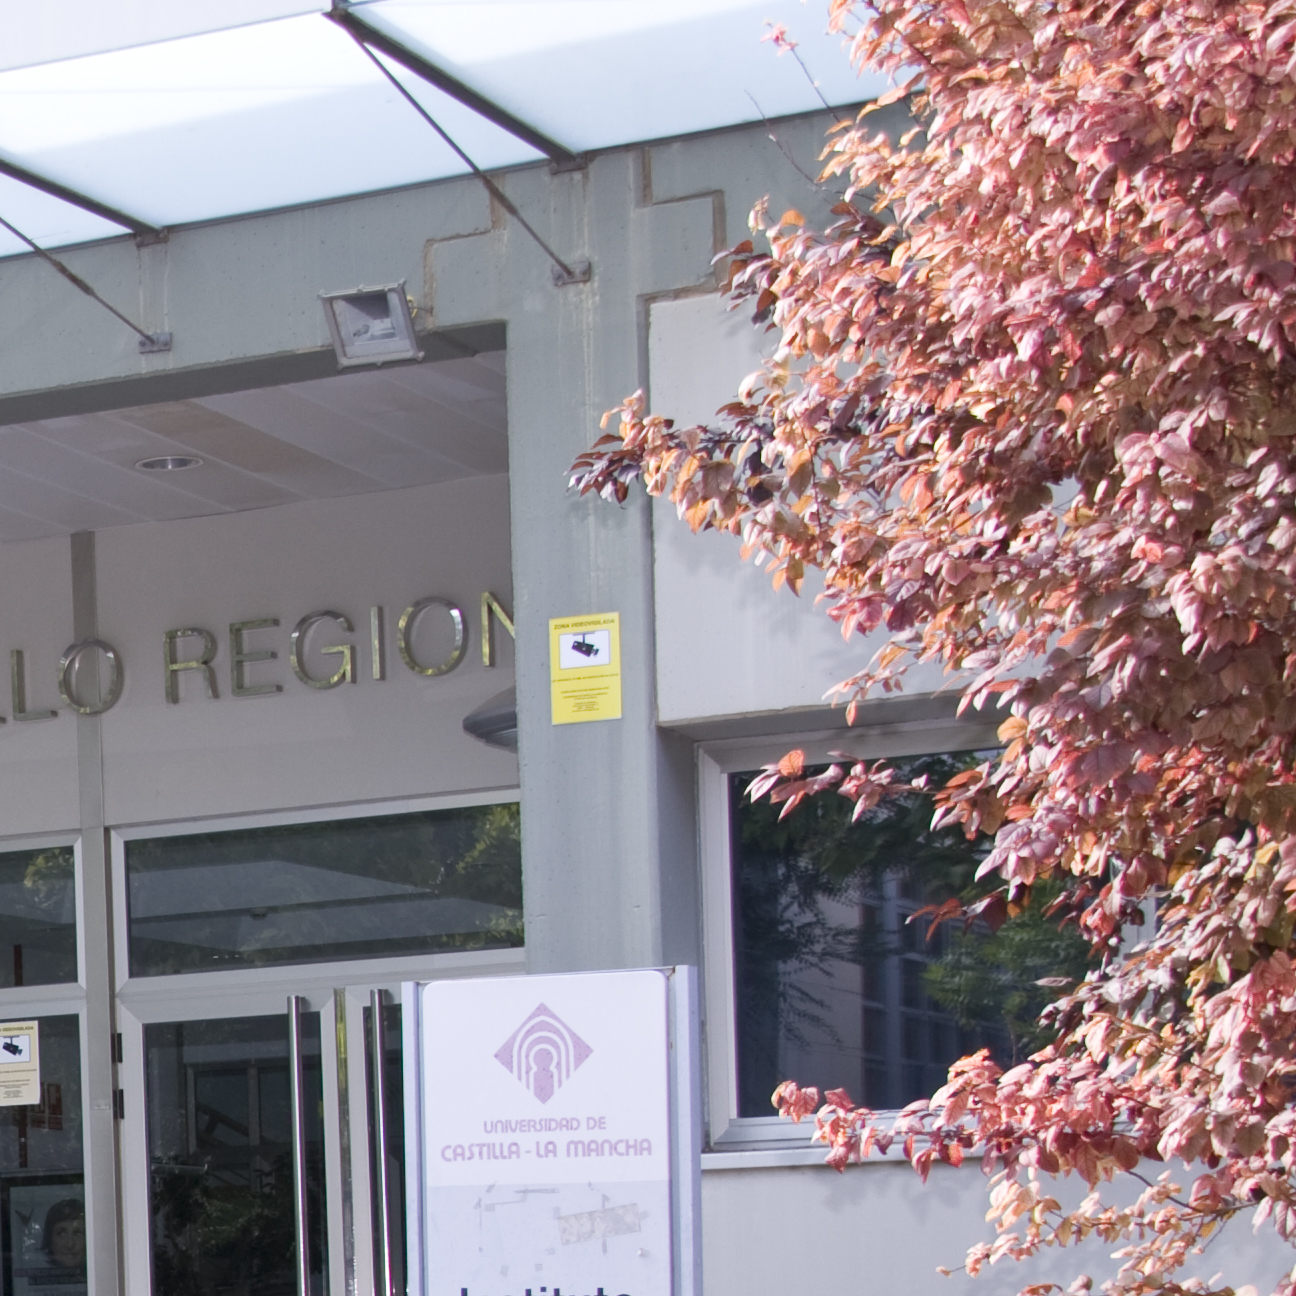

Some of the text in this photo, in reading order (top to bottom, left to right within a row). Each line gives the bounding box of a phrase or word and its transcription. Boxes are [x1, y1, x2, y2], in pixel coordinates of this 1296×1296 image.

[483, 1116, 607, 1134] UNIVERSIDAD DE
[440, 1142, 521, 1162] CASTILLA
[535, 1141, 558, 1159] LA
[566, 1138, 653, 1159] MANCHA
